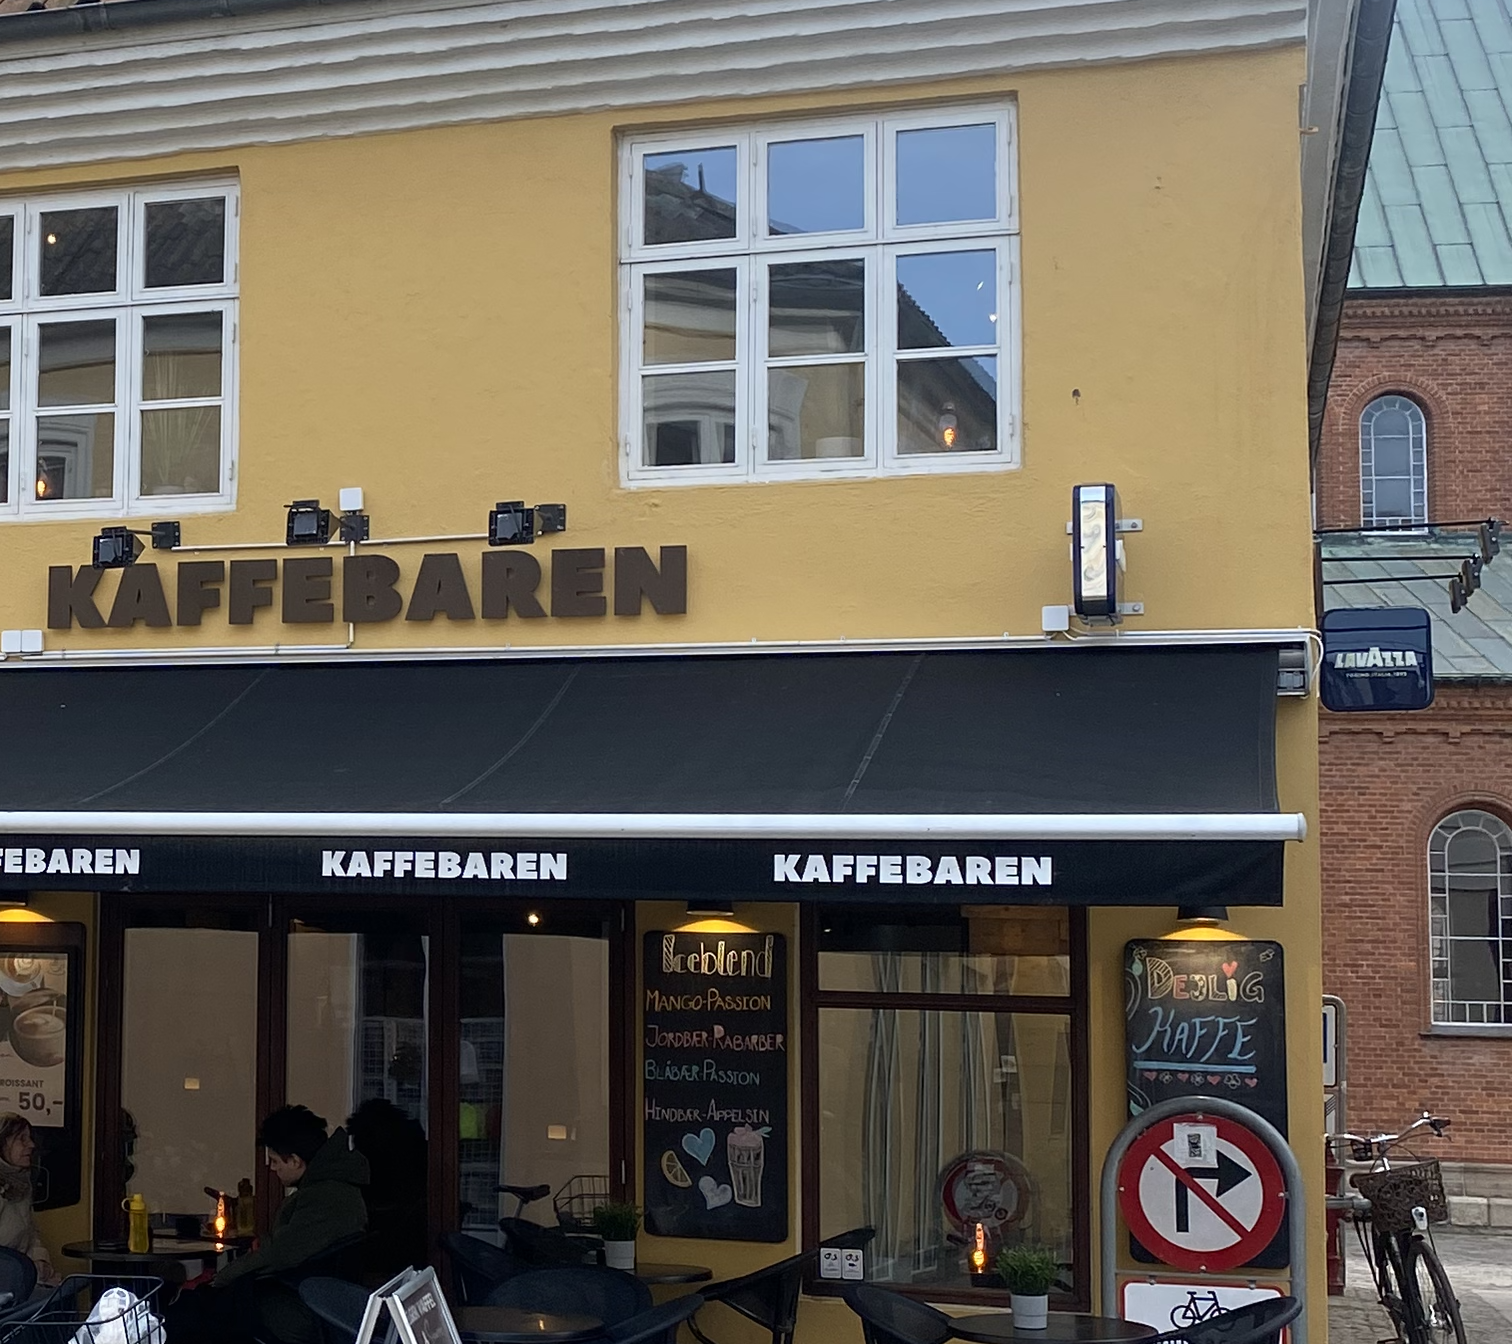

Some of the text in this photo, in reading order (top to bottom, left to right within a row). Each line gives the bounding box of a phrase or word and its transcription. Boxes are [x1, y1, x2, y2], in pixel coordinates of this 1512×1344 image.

[47, 545, 688, 630] KAFFEBAREN
[1334, 647, 1418, 669] LAVAZZA
[321, 850, 568, 880] KAFFEBAREN
[773, 854, 1052, 886] KAFFEBAREN
[1132, 1006, 1259, 1062] KAFFE
[18, 1092, 63, 1116] 50,-
